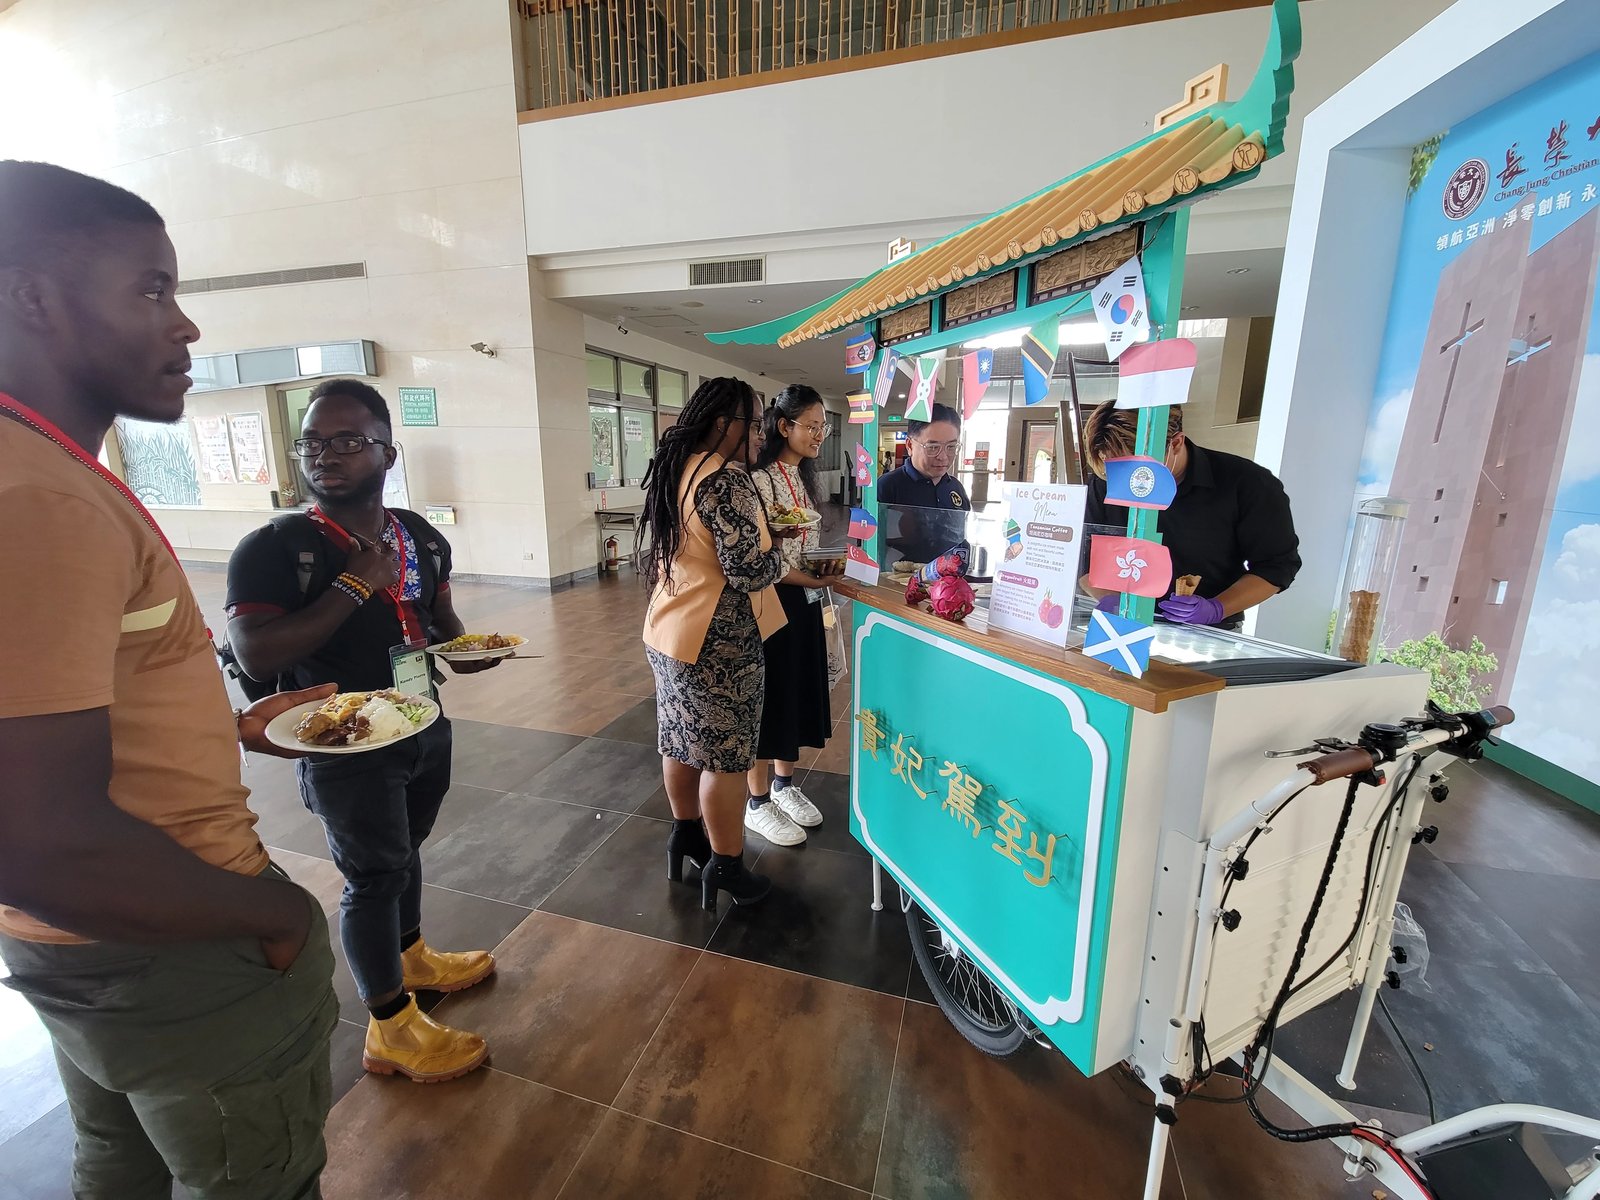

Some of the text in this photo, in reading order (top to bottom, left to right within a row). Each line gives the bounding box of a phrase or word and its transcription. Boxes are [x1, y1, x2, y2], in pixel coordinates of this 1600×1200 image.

[1494, 159, 1598, 202] Chang Jung Christian
[1436, 183, 1598, 250] 領航亞洲 淨零創新 永
[1016, 488, 1066, 501] Ice Cream
[1034, 501, 1057, 522] Menu
[1052, 526, 1068, 534] Coffee
[855, 709, 1056, 887] 貴妃駕到
